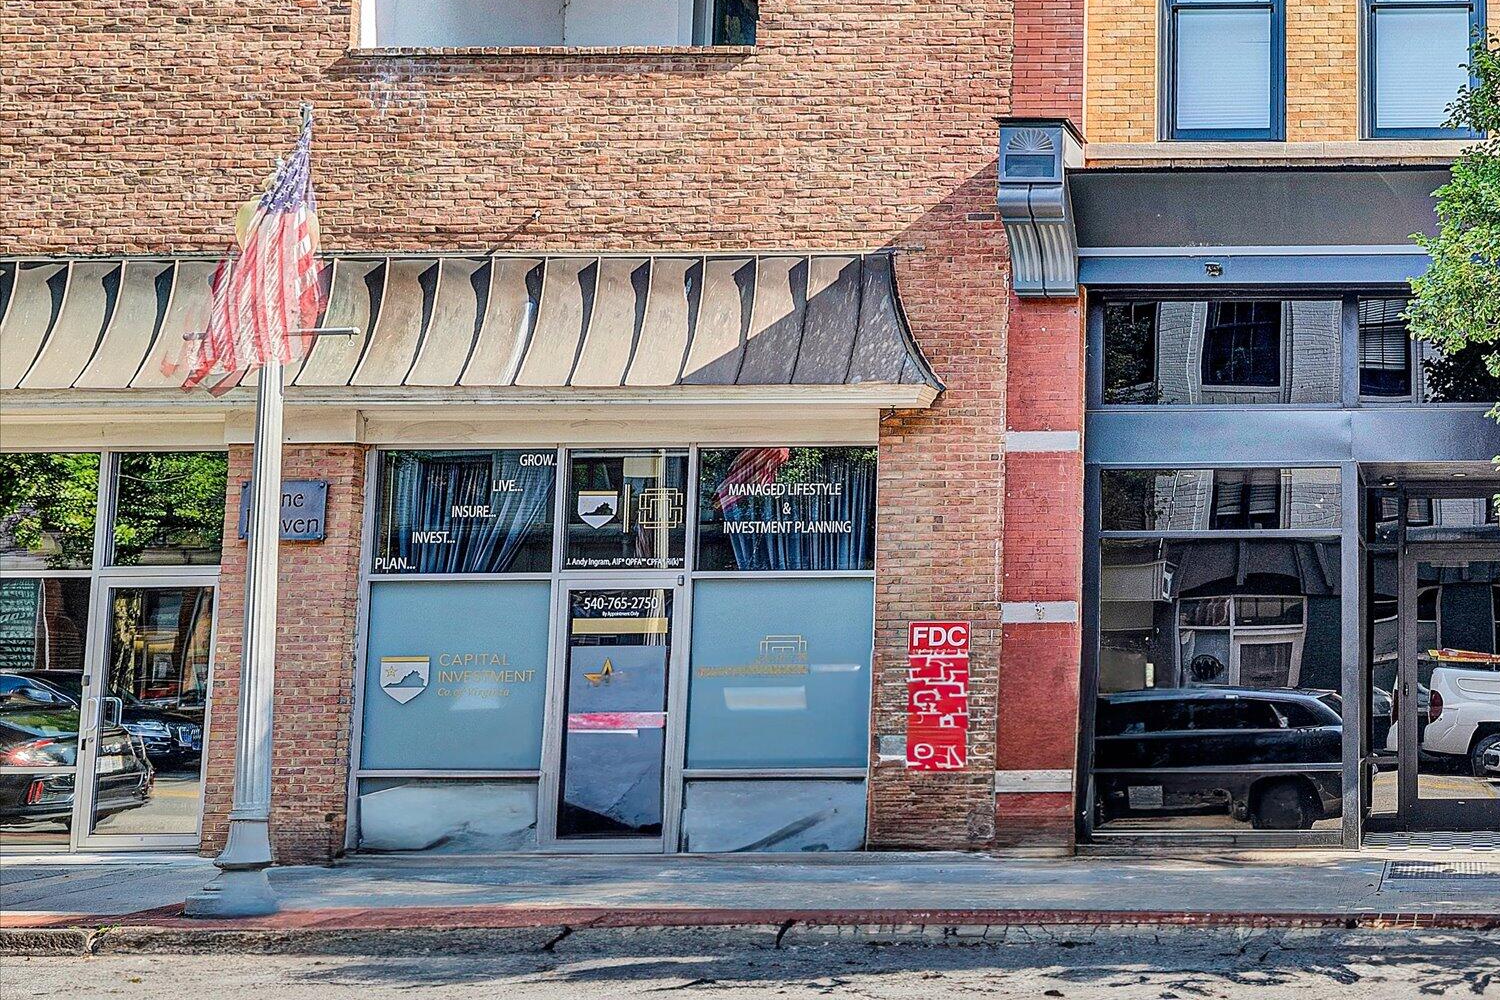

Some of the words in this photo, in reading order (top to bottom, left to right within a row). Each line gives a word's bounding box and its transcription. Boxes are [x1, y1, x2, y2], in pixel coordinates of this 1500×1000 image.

[492, 479, 524, 492] LIVE...
[728, 483, 786, 496] MANAGED
[788, 483, 842, 496] LIFESTYLE
[281, 492, 305, 508] ne
[451, 505, 497, 518] INSURE...
[782, 501, 792, 515] &
[723, 521, 793, 534] INVESTMENT
[794, 520, 852, 533] PLANNING
[411, 531, 456, 544] INVEST...
[374, 557, 416, 570] PLAN...
[572, 557, 588, 567] Andy
[588, 557, 611, 567] Ingram,
[583, 597, 658, 610] 540-765-2750
[912, 625, 967, 647] FDC
[439, 653, 511, 667] CAPITAL
[437, 669, 536, 683] INVESTMENT
